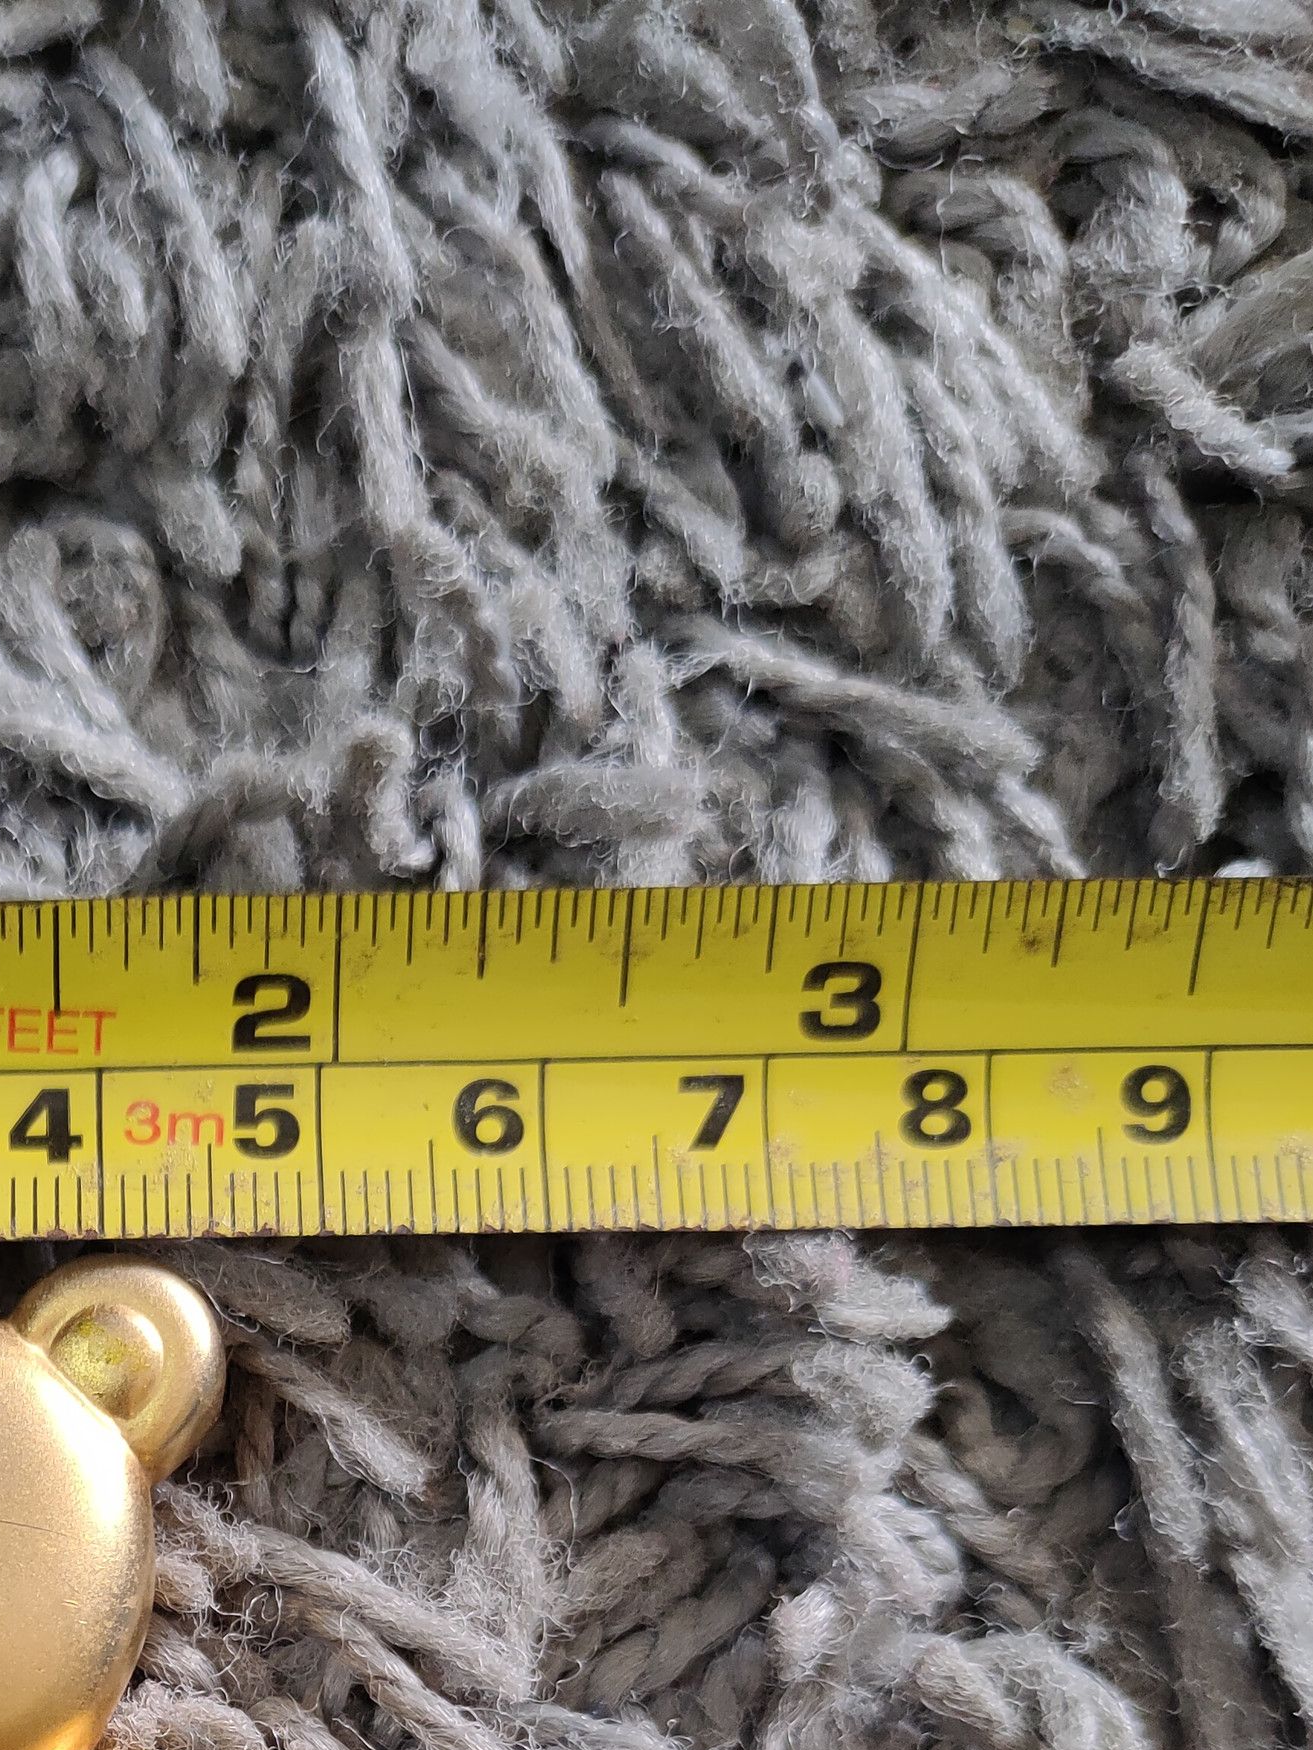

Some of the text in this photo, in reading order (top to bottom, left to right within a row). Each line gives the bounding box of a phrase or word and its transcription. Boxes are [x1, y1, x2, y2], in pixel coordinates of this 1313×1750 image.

[230, 974, 312, 1053] 2
[798, 961, 882, 1042] 3
[9, 1088, 83, 1164] 4
[123, 1100, 225, 1148] 3m
[232, 1084, 300, 1158] 5
[453, 1079, 525, 1155] 6
[677, 1074, 746, 1151] 7
[898, 1069, 971, 1150] 8
[1120, 1065, 1192, 1144] 9
